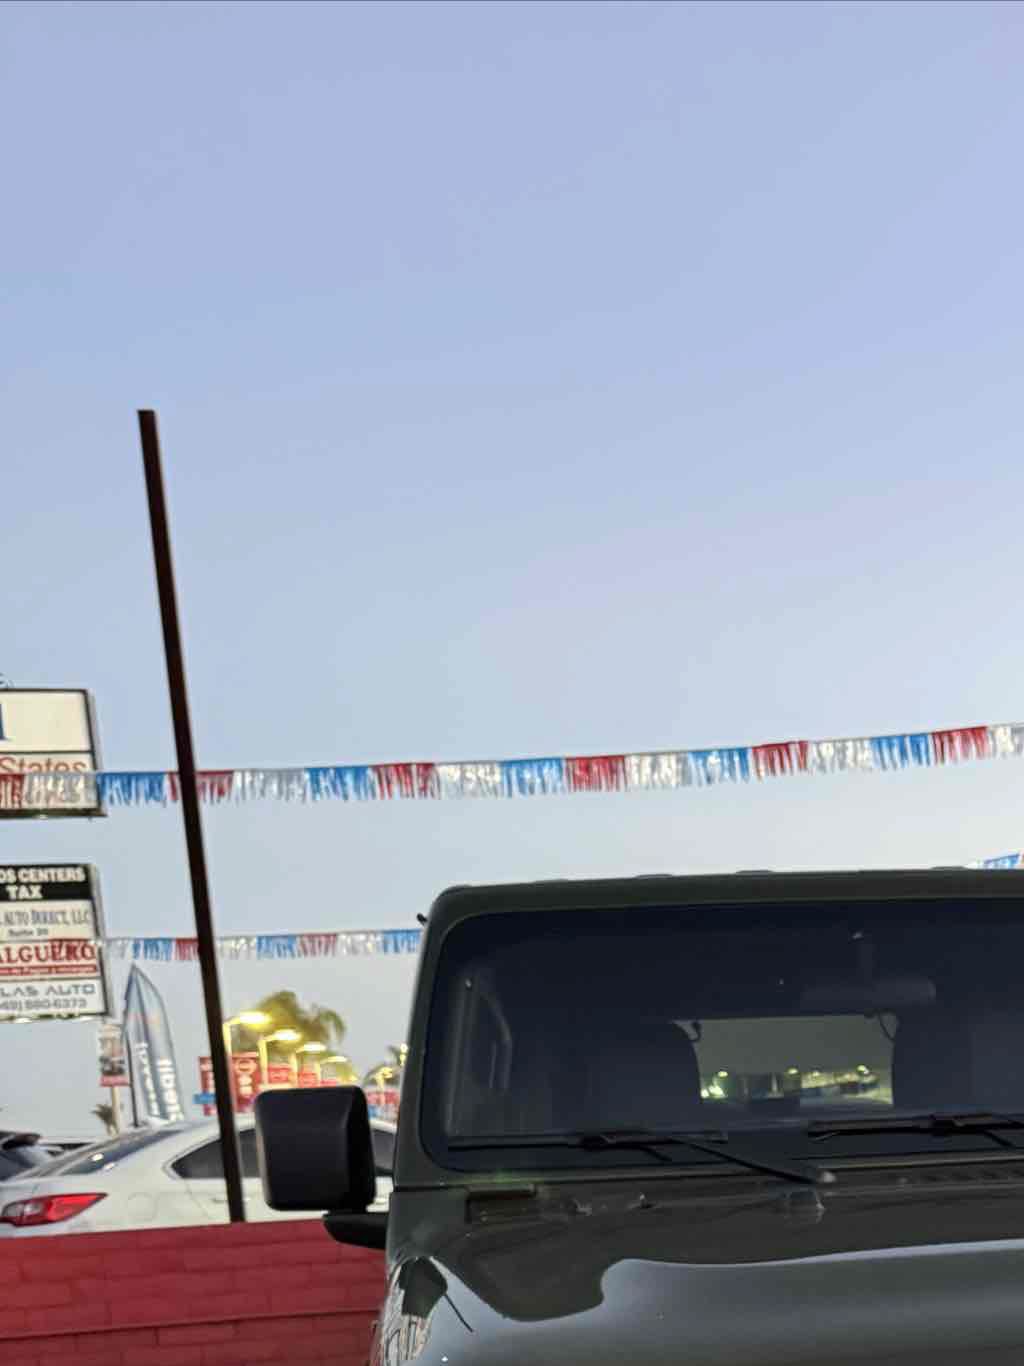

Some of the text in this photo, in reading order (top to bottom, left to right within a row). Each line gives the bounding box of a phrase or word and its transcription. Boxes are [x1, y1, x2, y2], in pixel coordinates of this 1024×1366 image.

[18, 867, 86, 882] CENTERS
[6, 884, 43, 899] TAX
[45, 984, 96, 996] AUTO
